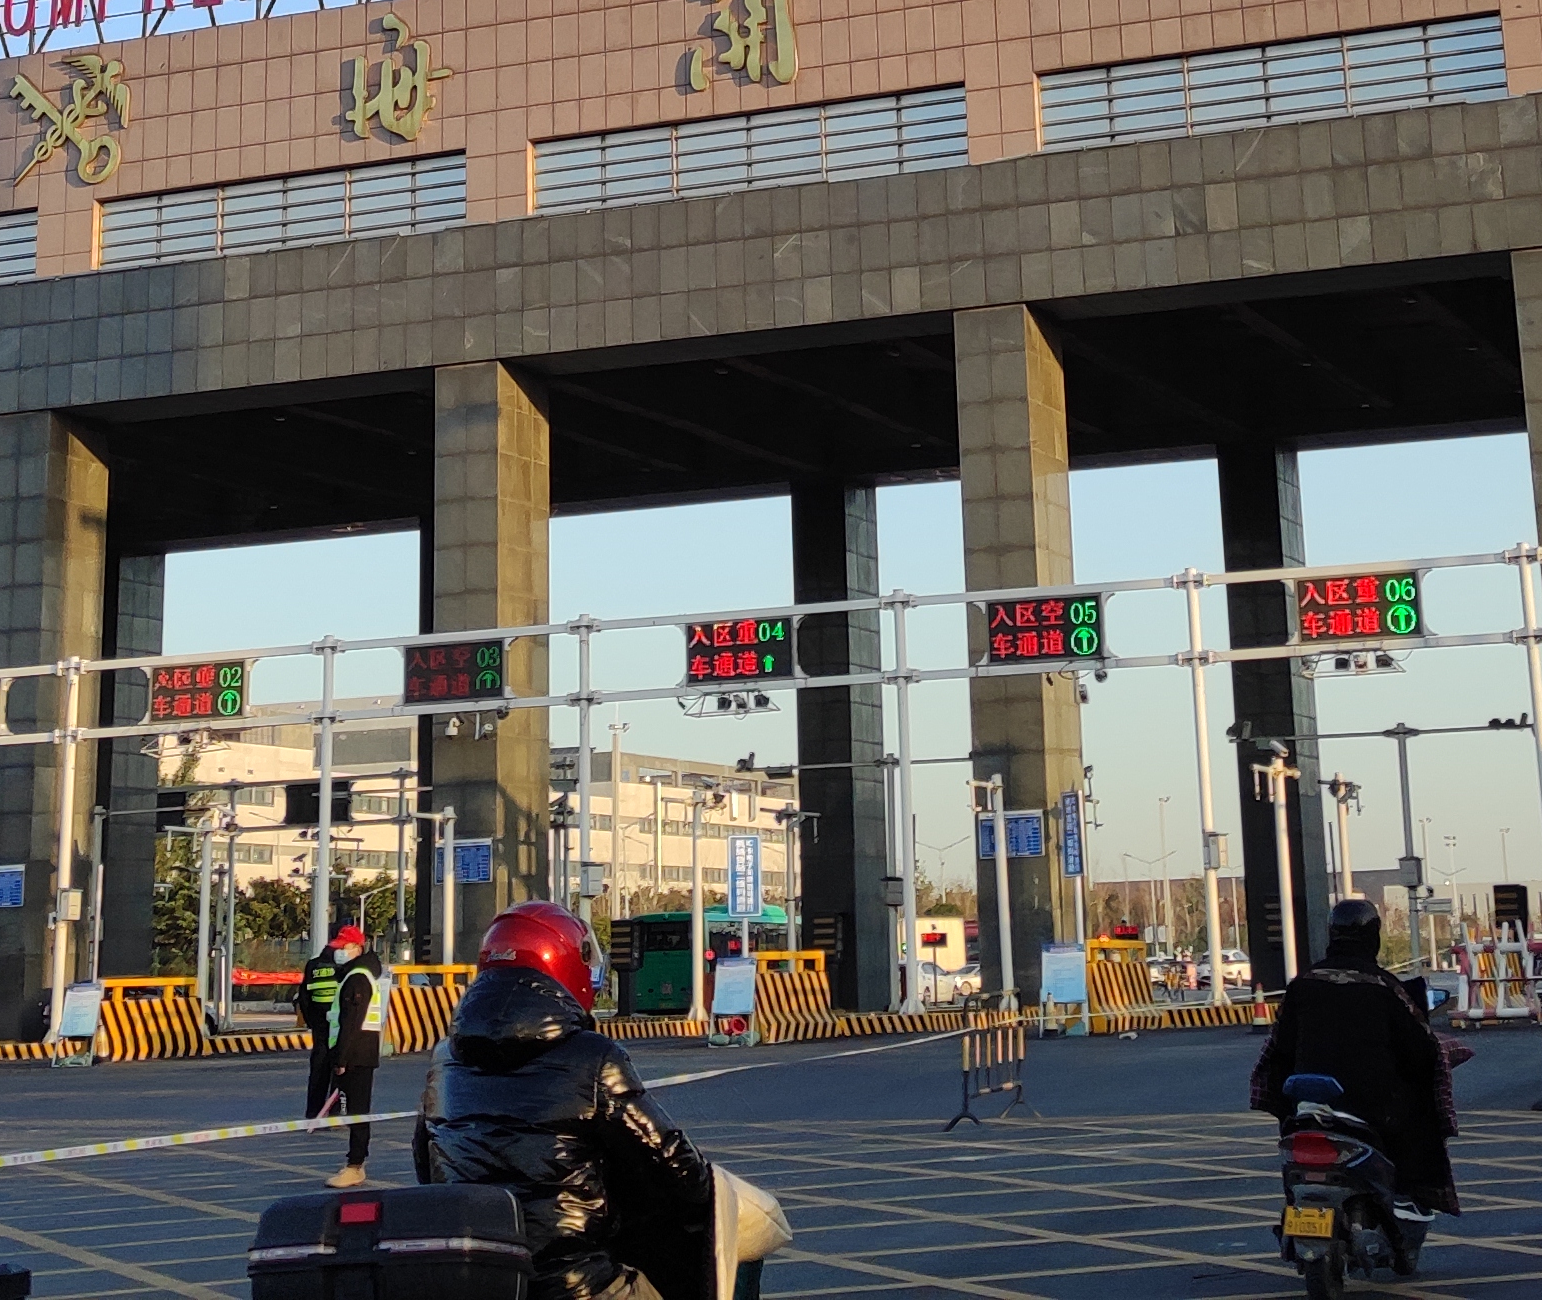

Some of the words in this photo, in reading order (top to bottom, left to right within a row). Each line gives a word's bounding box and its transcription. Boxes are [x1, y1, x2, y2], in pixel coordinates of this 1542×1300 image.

[1300, 576, 1380, 607] 入区重
[1385, 578, 1416, 603] 06
[990, 599, 1065, 629] 入区空
[1069, 601, 1097, 625] 05
[1301, 607, 1381, 639] 车通道
[688, 619, 758, 648] 入区重
[758, 619, 785, 642] 04
[991, 629, 1065, 659] 车通道
[476, 646, 500, 667] 03
[689, 650, 758, 680] 车通道
[219, 666, 242, 688] 02
